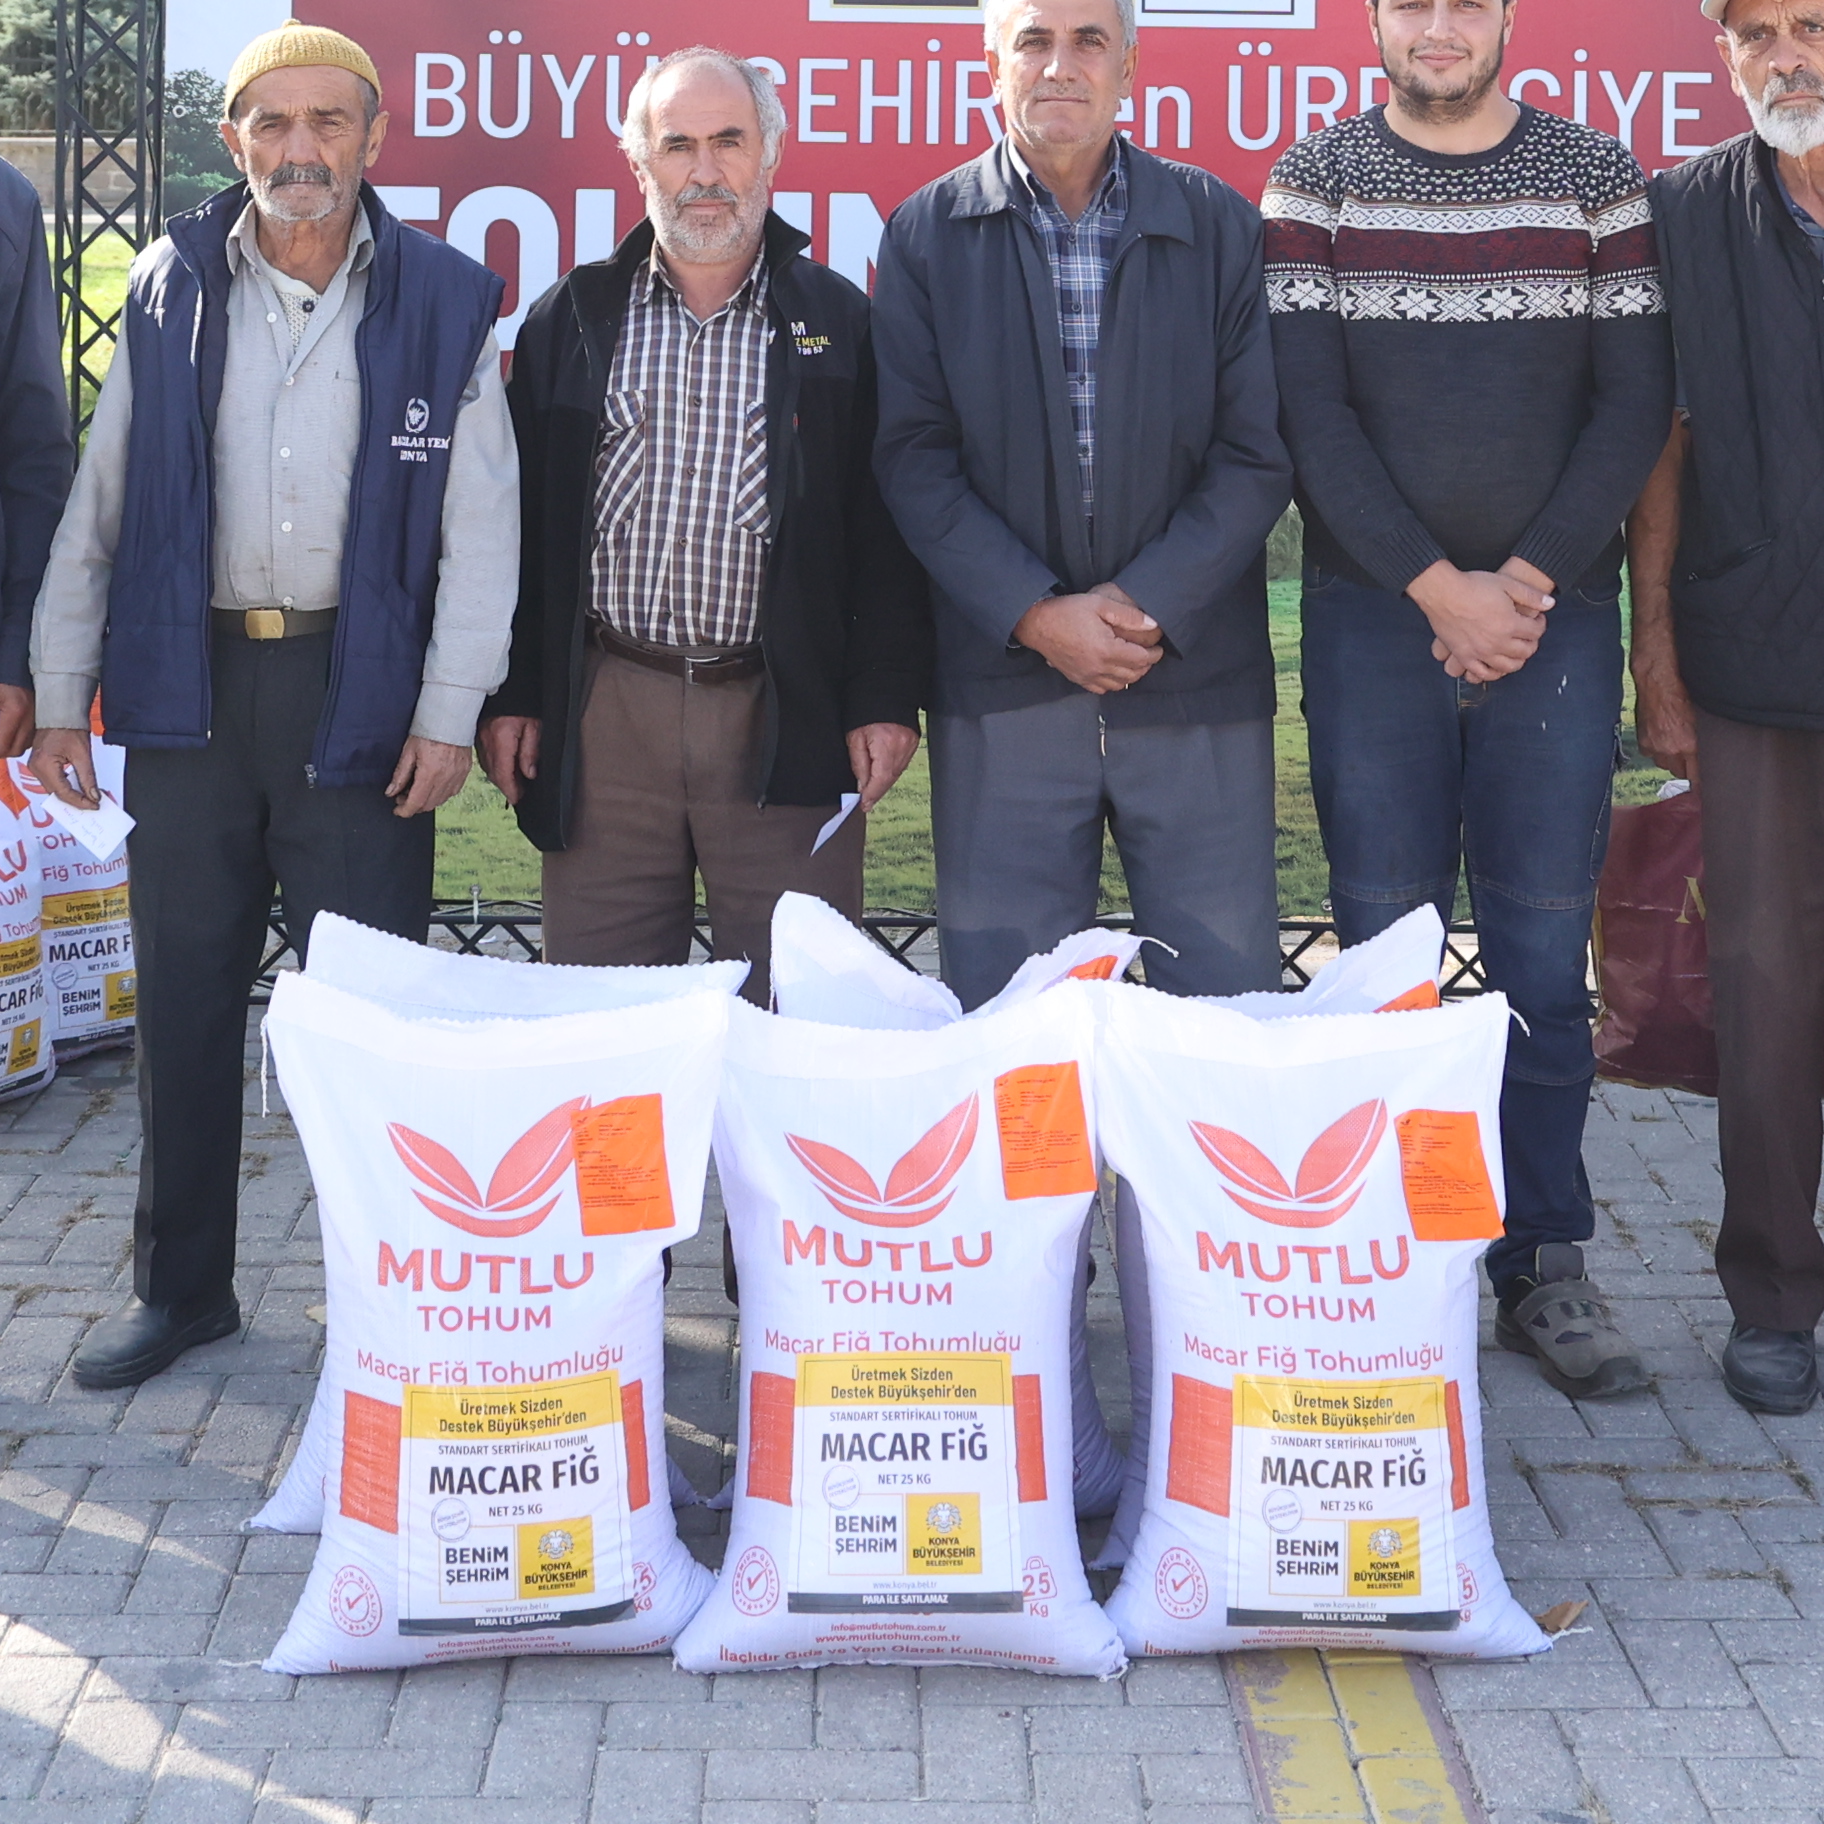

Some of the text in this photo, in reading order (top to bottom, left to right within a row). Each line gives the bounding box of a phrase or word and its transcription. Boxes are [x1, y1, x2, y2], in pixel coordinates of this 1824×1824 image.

[802, 336, 832, 347] METAL
[42, 865, 68, 881] Fiğ
[49, 939, 118, 963] MACAR
[783, 1219, 992, 1272] MUTLU
[1196, 1230, 1409, 1284] MUTLU
[378, 1240, 593, 1294] MUTLU
[822, 1280, 952, 1305] TOHUM
[1241, 1292, 1375, 1322] TOHUM
[417, 1305, 551, 1331] TOHUM
[766, 1328, 1021, 1353] Macar Fiğ Tohumluğu
[1185, 1332, 1443, 1374] Macar Fiğ Tohumluğu
[358, 1344, 623, 1386] Macar Fiğ Tohumluğu
[852, 1365, 952, 1381] Üretmek Sizden
[831, 1385, 976, 1401] Destek Büyükşehir'den
[1295, 1391, 1393, 1409] Üretmek Sizden
[461, 1398, 562, 1416] Üretmek Sizden
[830, 1408, 977, 1422] STANDART SERTİFİKALI TOHUM
[440, 1411, 586, 1435] Destek Büyükşehir'den
[1273, 1409, 1415, 1429] Destek Büyükşehir'den
[438, 1435, 588, 1455] STANDART SERTİFİKALI TOHUM
[821, 1433, 931, 1462] MACAR
[1271, 1436, 1417, 1449] STANDART SERTİFİKALI TOHUM
[429, 1464, 542, 1495] MACAR
[878, 1474, 931, 1484] NET 25 KG
[1261, 1456, 1373, 1489] MACAR
[489, 1504, 543, 1517] NET 25 KG
[1320, 1500, 1373, 1511] NET 25 KG
[929, 1537, 960, 1546] KONYA
[913, 1546, 975, 1559] BÜYÜKŞEHİR
[541, 1561, 572, 1572] KONYA
[1370, 1561, 1400, 1570] KONYA
[1023, 1572, 1051, 1597] 25
[1462, 1577, 1473, 1600] 5
[863, 1595, 885, 1605] PARA
[901, 1594, 948, 1604] SATILAMAZ
[1030, 1603, 1049, 1618] Kg
[1302, 1612, 1324, 1621] PARA
[1340, 1612, 1387, 1622] SATILAMAZ
[476, 1618, 496, 1627] PARA
[514, 1613, 561, 1624] SATILAMAZ
